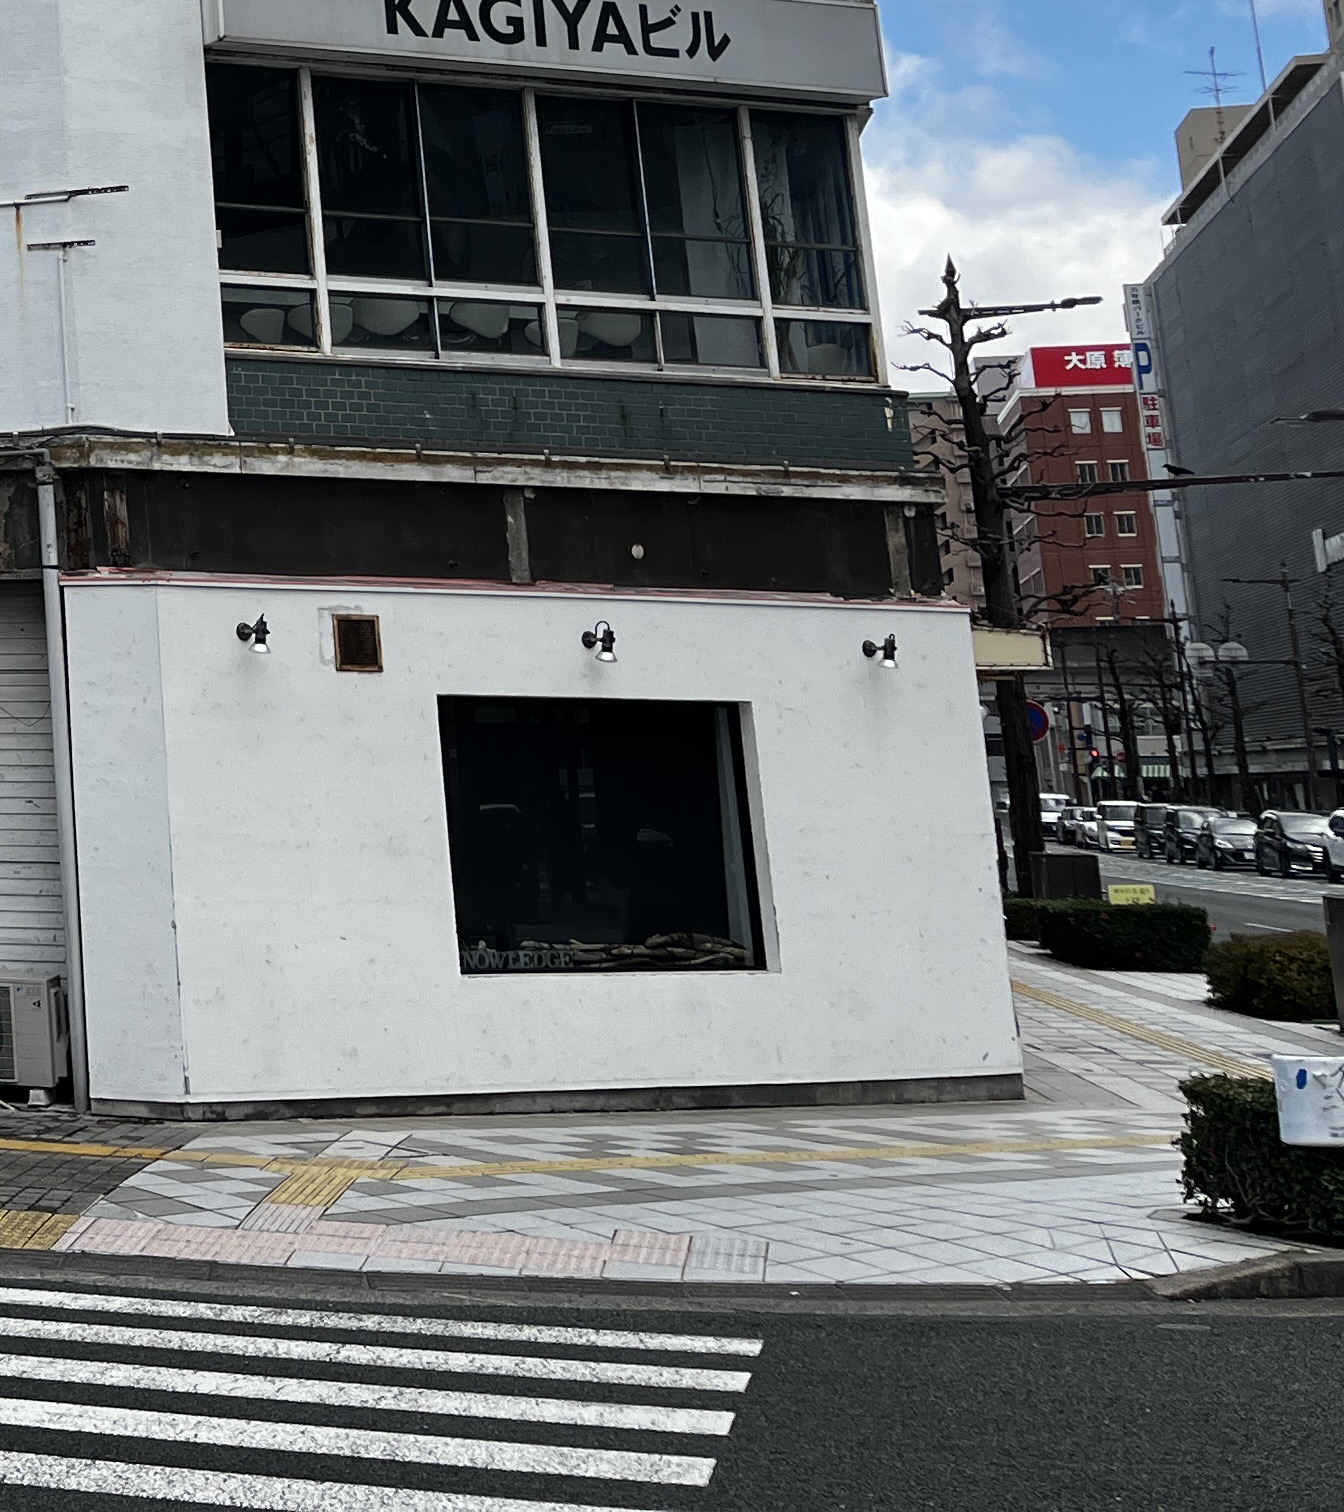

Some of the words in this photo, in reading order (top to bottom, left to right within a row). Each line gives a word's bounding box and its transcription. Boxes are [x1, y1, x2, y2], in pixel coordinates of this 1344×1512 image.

[1064, 351, 1108, 370] 大原
[1142, 396, 1164, 447] 駐車場
